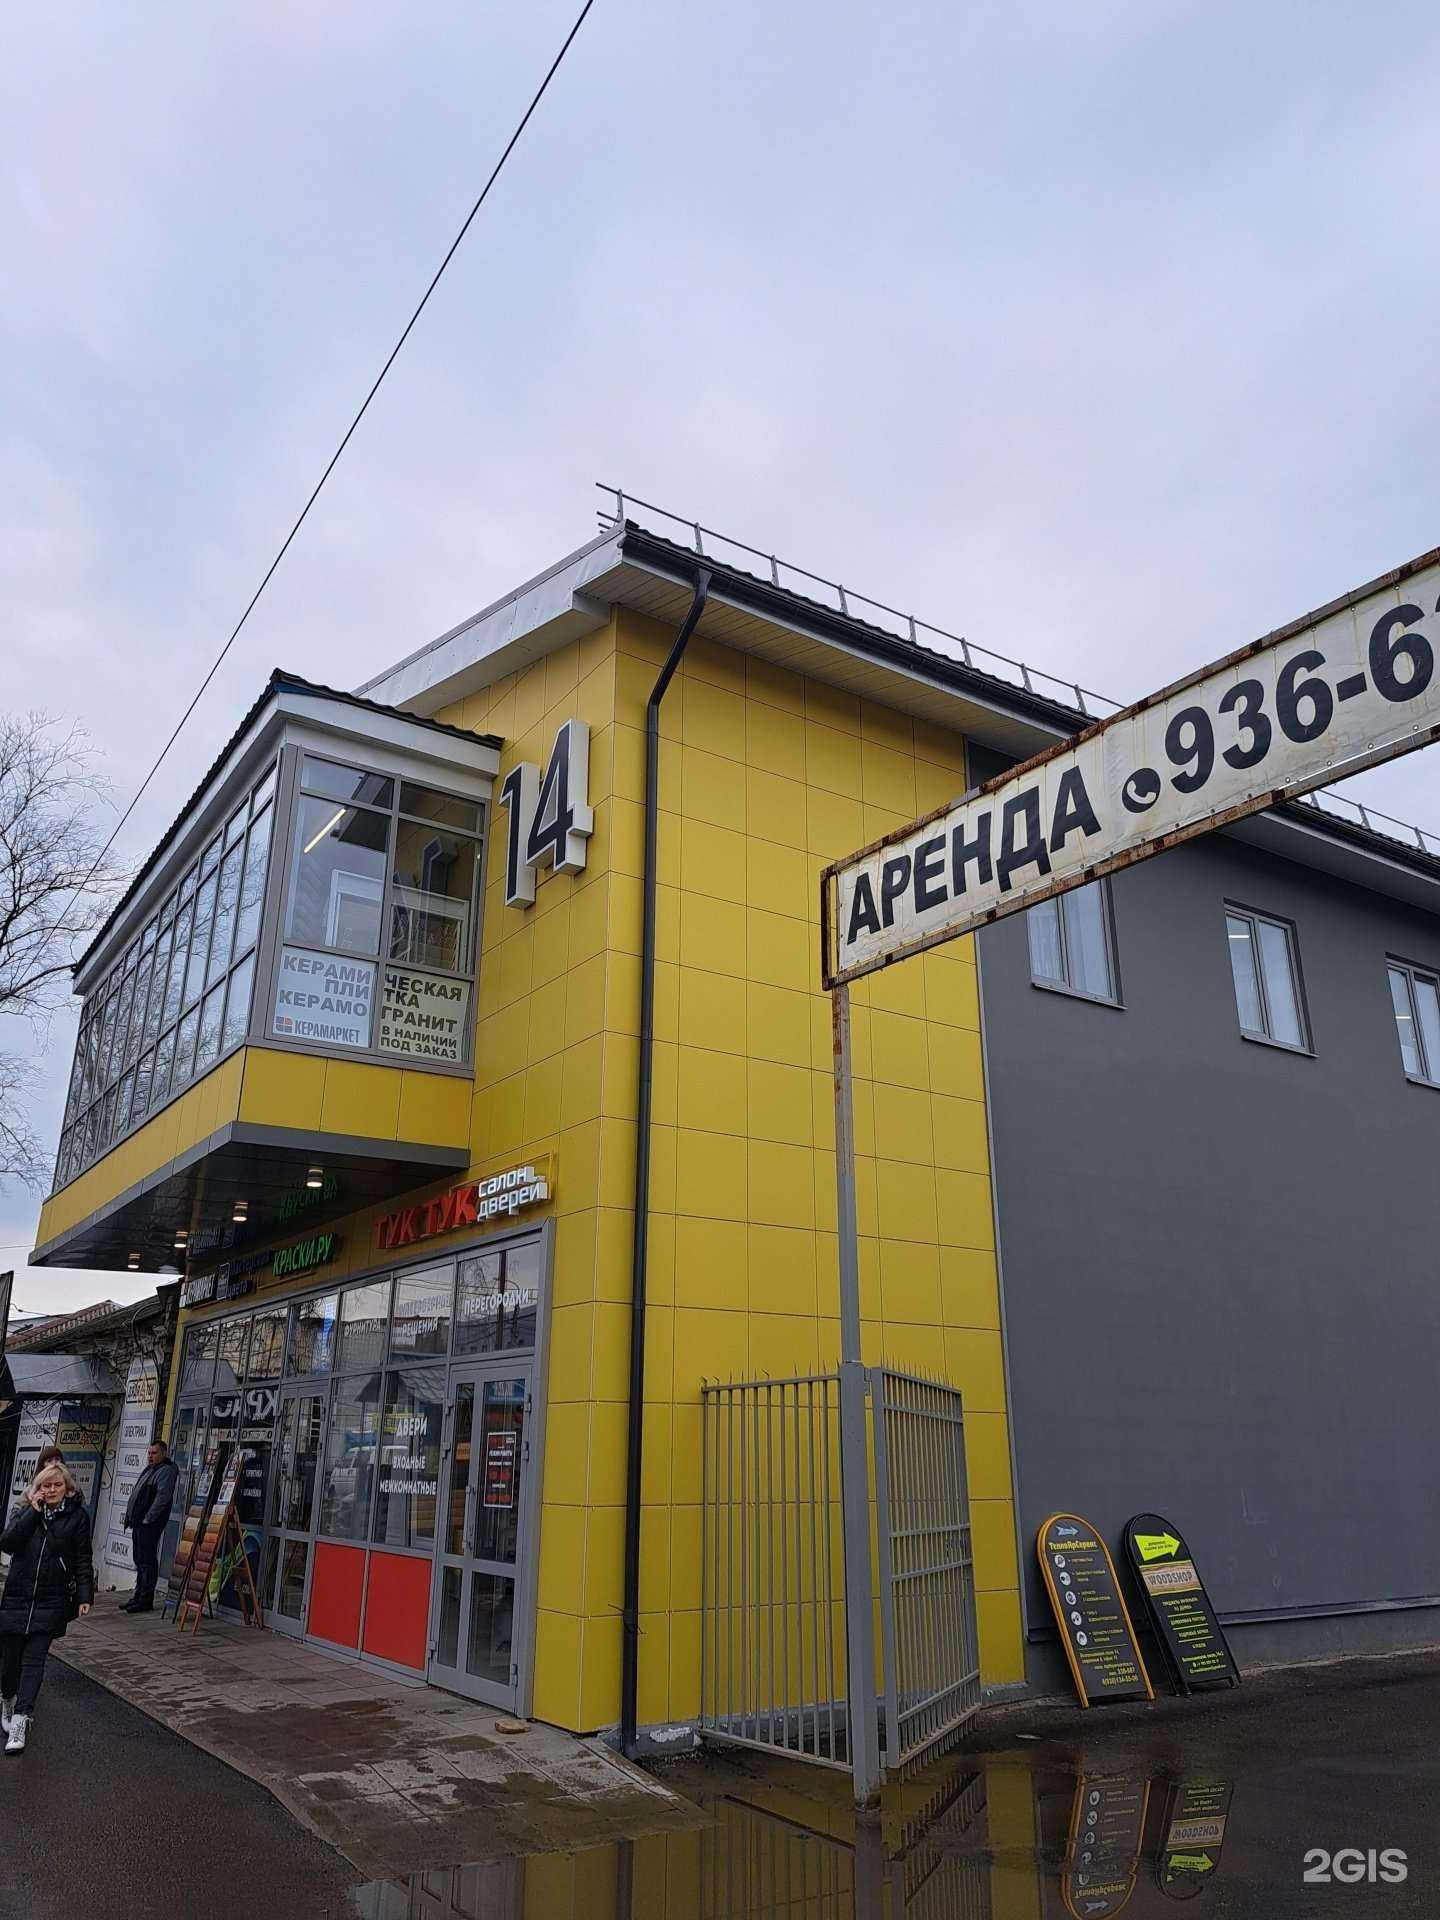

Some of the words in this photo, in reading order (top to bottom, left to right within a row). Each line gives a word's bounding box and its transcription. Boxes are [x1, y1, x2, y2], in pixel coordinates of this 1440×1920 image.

[846, 765, 1102, 945] АРЕНДА
[1165, 594, 1440, 794] 936-6
[499, 719, 590, 908] 14
[283, 954, 371, 986] КЕРАМИ
[324, 978, 370, 1000] ПЛИ
[384, 988, 420, 1009] ТКА
[385, 973, 463, 1002] ЧЕСКАЯ
[278, 989, 368, 1018] КЕРАМО
[294, 1019, 361, 1044] КЕРАМАРКЕТ
[381, 1005, 458, 1033] ГРАНИТ
[380, 1035, 411, 1053] ПОД
[414, 1042, 458, 1061] ЗАКАЗ
[381, 1025, 392, 1036] В
[394, 1028, 458, 1049] НАЛИЧИИ
[478, 1166, 534, 1198] салон
[374, 1207, 417, 1249] ТУК
[420, 1187, 477, 1237] ТУК
[272, 1233, 333, 1277] КРАСКИ.РУ
[464, 1288, 529, 1315] ПЕРЕГОРОДКИ
[396, 1416, 428, 1437] ДВЕРИ
[392, 1455, 426, 1470] ВХОДНЫЕ
[379, 1480, 437, 1496] МЕЖКОМНАТНЫЕ
[1147, 1571, 1193, 1586] WOODSHOP
